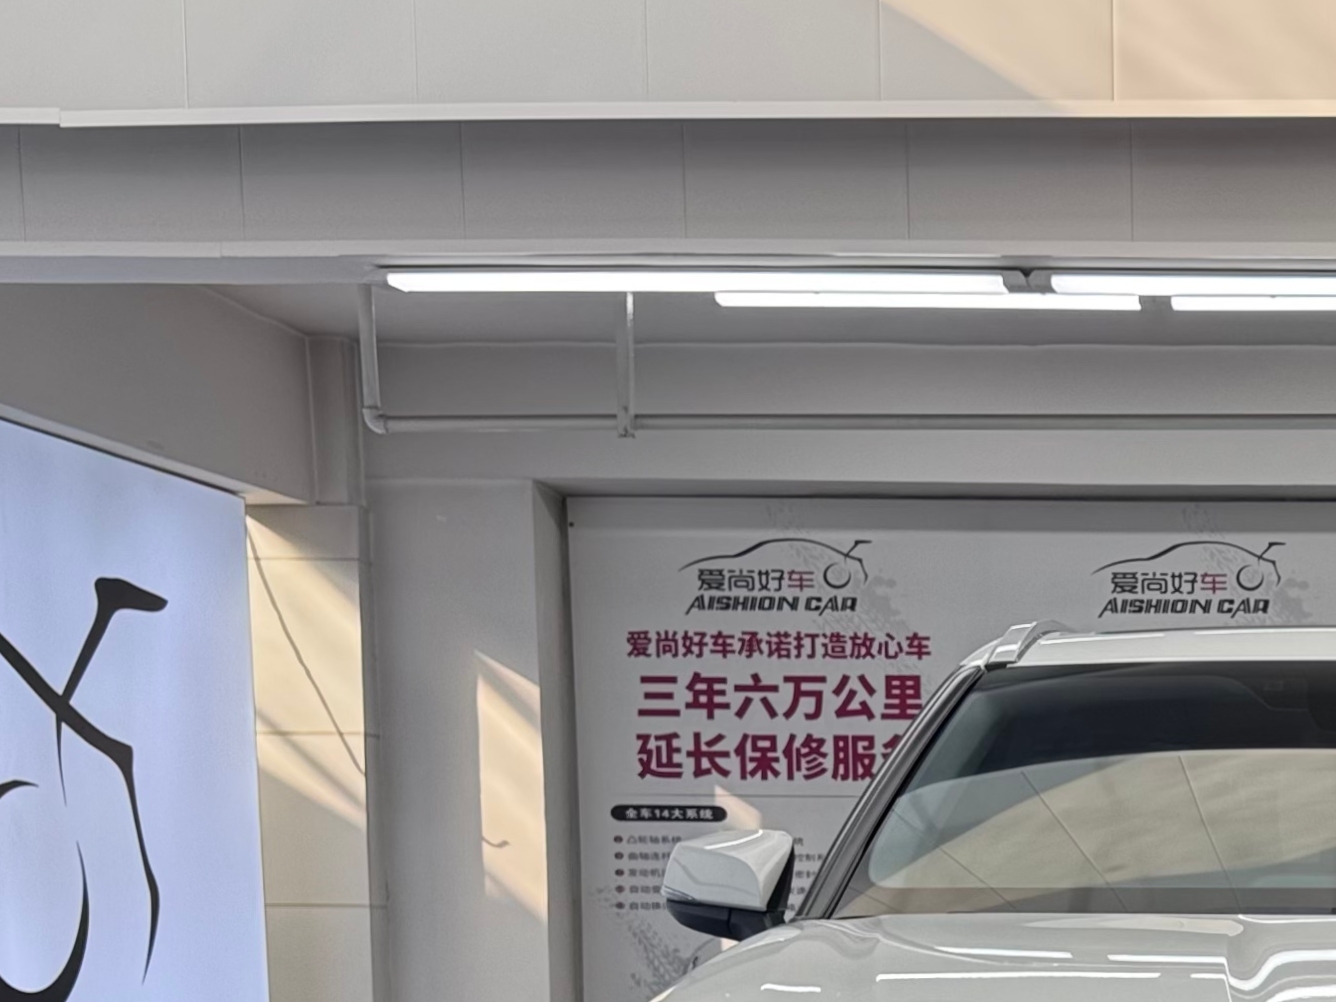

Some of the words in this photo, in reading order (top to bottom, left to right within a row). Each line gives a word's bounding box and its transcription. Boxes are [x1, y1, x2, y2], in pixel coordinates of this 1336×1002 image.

[697, 568, 815, 593] 爱尚好车
[1110, 571, 1228, 595] 爱尚好车
[685, 594, 800, 616] AISHION
[803, 594, 858, 616] CAR
[1098, 596, 1214, 619] AISHION
[1216, 596, 1271, 619] CAR
[626, 629, 932, 661] 爱尚好车承诺打造放心车
[637, 671, 923, 721] 三年六万公里
